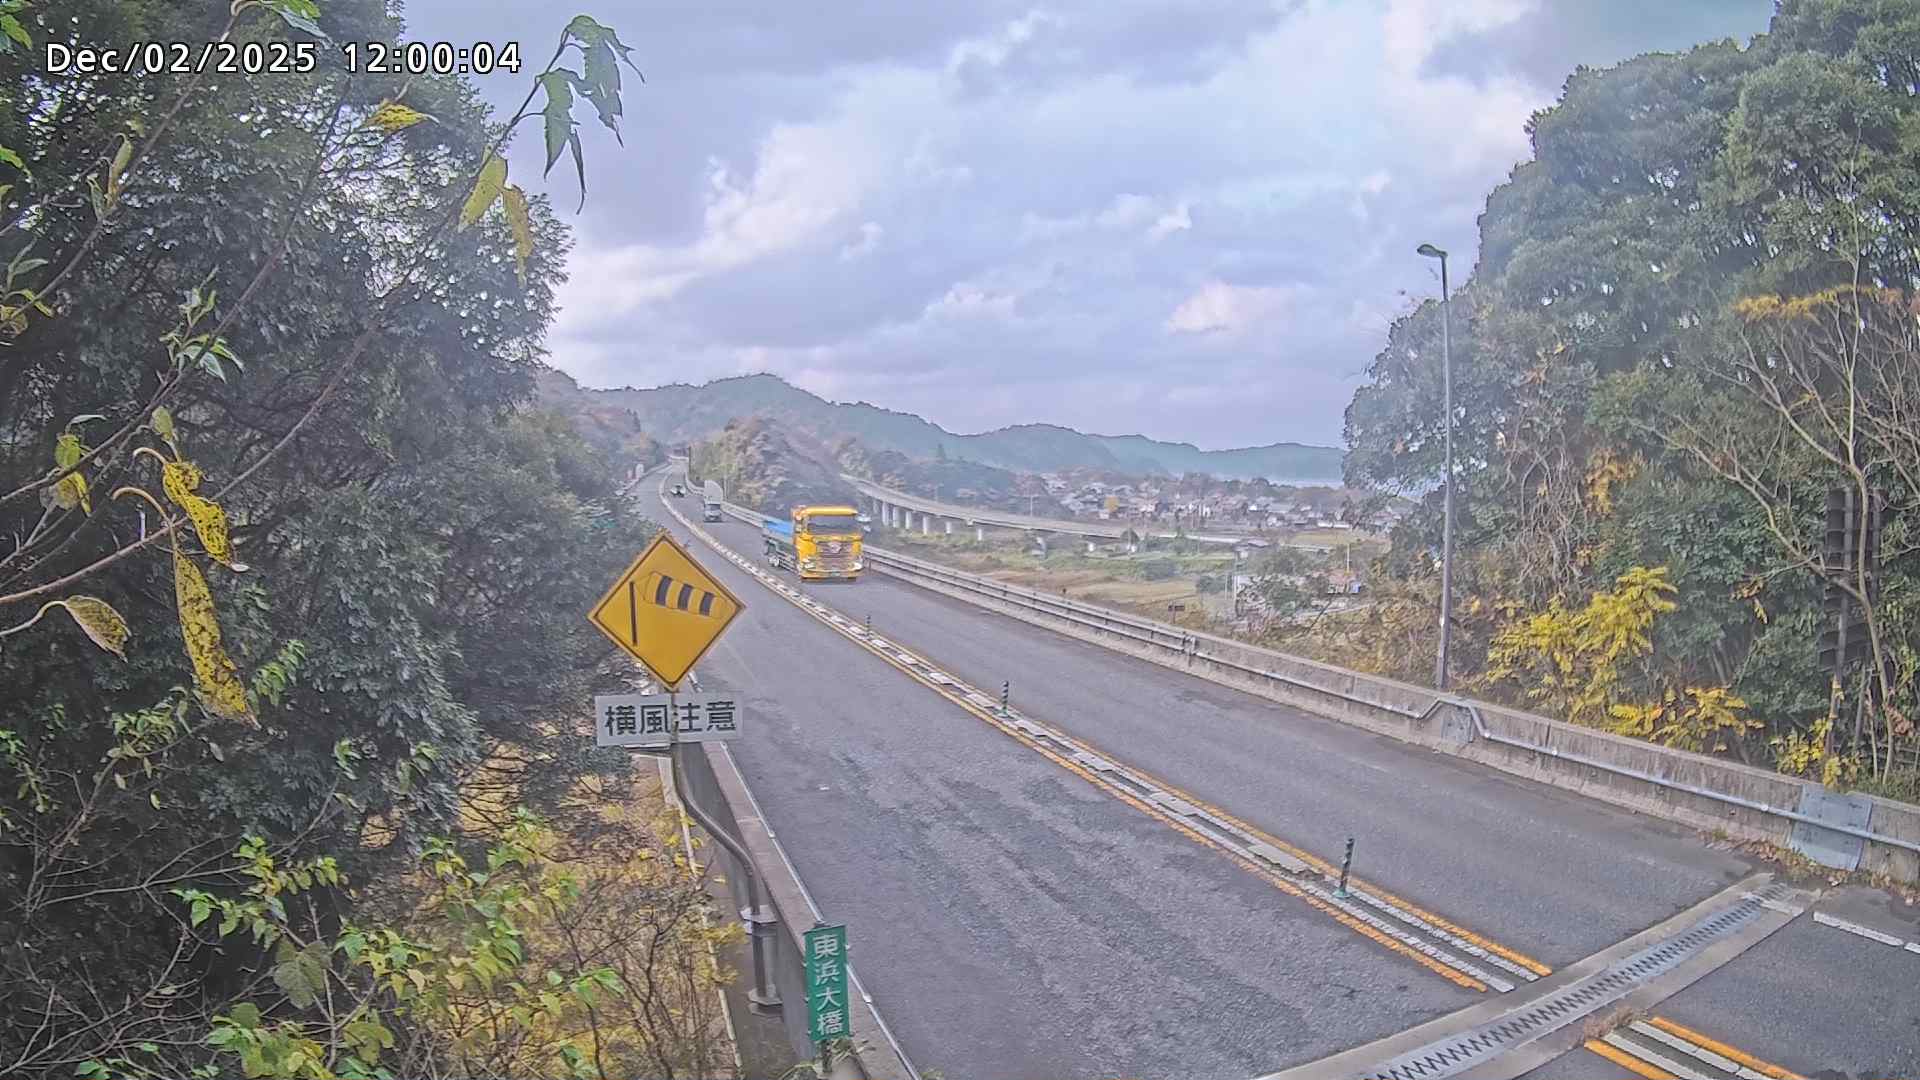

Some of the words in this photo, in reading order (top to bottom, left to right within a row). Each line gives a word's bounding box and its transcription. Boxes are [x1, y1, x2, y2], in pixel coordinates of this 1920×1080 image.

[604, 701, 736, 737] 横風注意
[812, 934, 843, 1036] 東浜大橋
